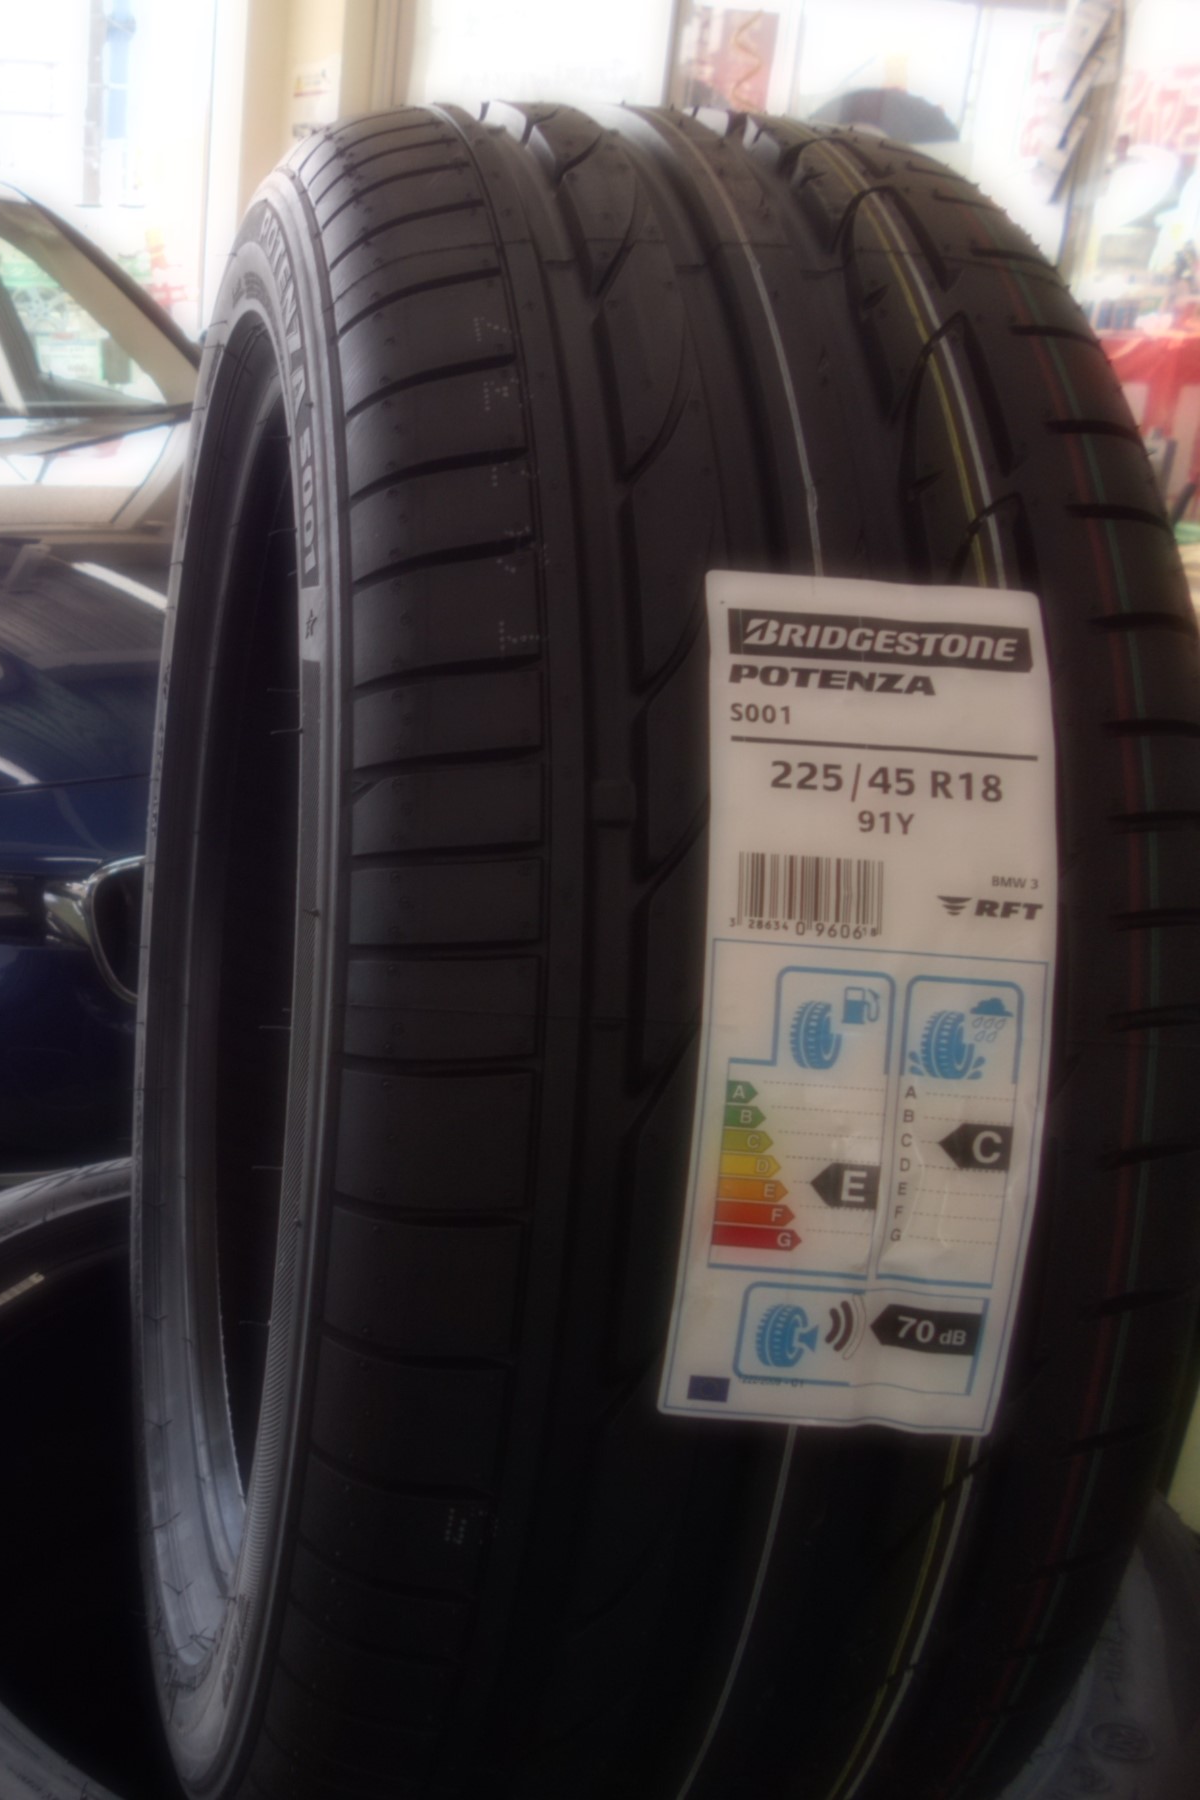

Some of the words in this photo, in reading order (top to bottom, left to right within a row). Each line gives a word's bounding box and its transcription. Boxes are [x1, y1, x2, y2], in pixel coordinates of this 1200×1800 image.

[259, 209, 307, 417] POTENZA
[301, 426, 317, 575] S001
[743, 618, 1019, 662] BRIDGESTONE
[728, 663, 936, 696] POTENZA
[729, 702, 791, 725] S001
[930, 771, 1004, 803] R18
[857, 810, 915, 836] 91Y
[990, 874, 1026, 890] BMW
[1030, 878, 1039, 891] 3
[974, 899, 1043, 921] RFT
[732, 1084, 746, 1099] A
[905, 1086, 917, 1099] A
[739, 1110, 753, 1125] B
[903, 1109, 915, 1123] B
[746, 1134, 760, 1149] C
[900, 1133, 913, 1147] C
[972, 1131, 1002, 1164] C
[755, 1159, 769, 1174] D
[898, 1158, 911, 1172] D
[763, 1183, 776, 1198] E
[840, 1170, 868, 1202] E
[770, 1207, 784, 1223] F
[776, 1232, 791, 1248] G
[897, 1316, 935, 1342] 70
[939, 1327, 967, 1346] dB
